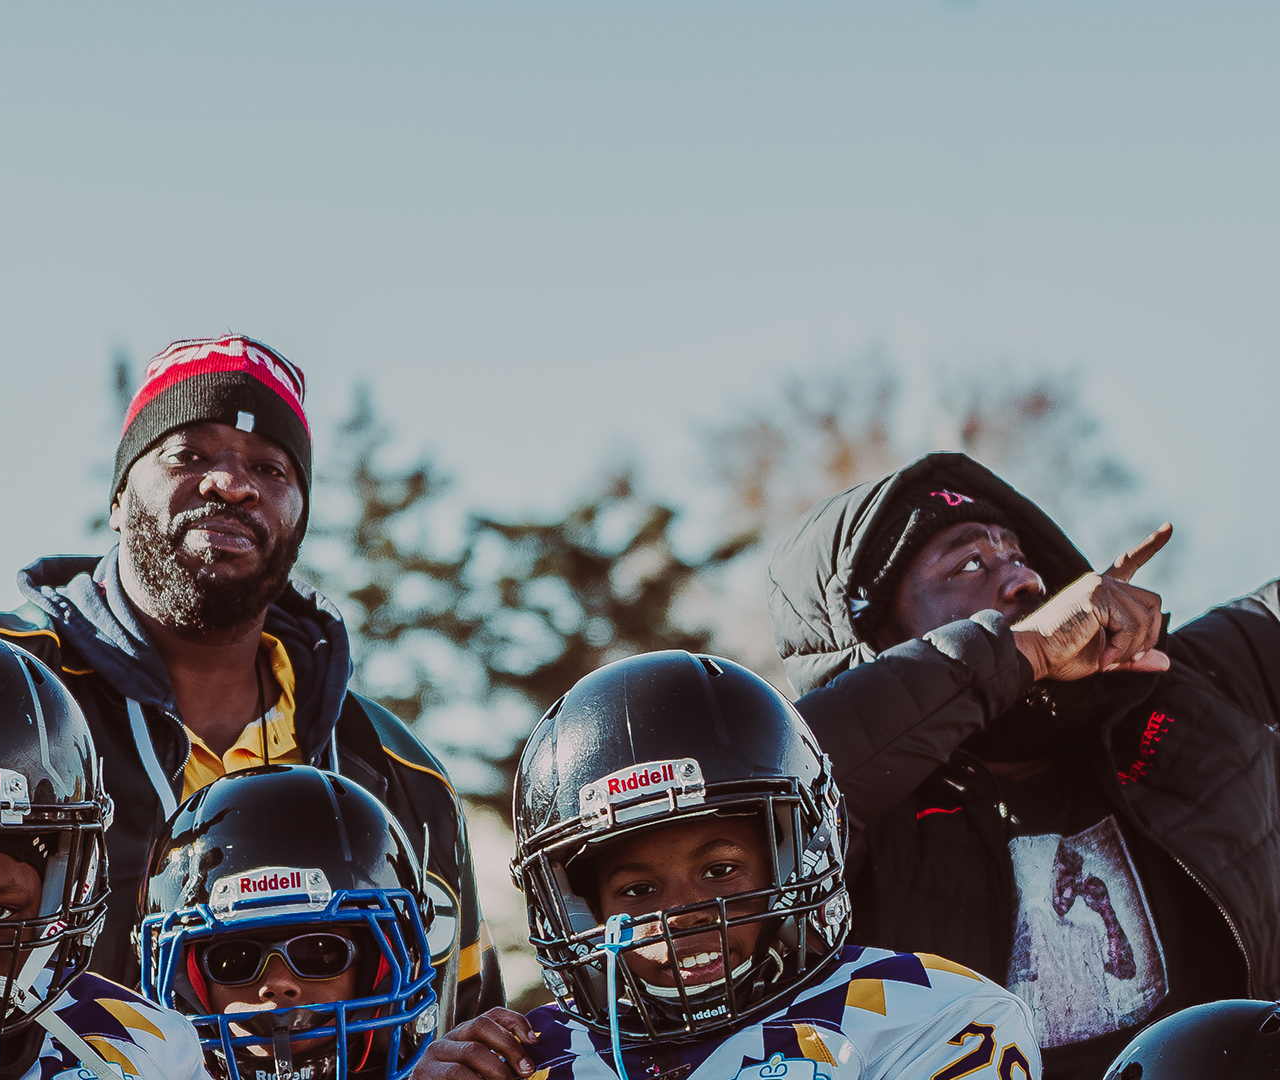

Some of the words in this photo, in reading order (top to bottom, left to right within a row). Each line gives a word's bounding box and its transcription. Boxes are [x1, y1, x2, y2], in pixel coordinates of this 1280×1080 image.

[607, 763, 674, 796] Riddell
[240, 872, 301, 893] Riddell
[682, 1005, 726, 1021] iddell
